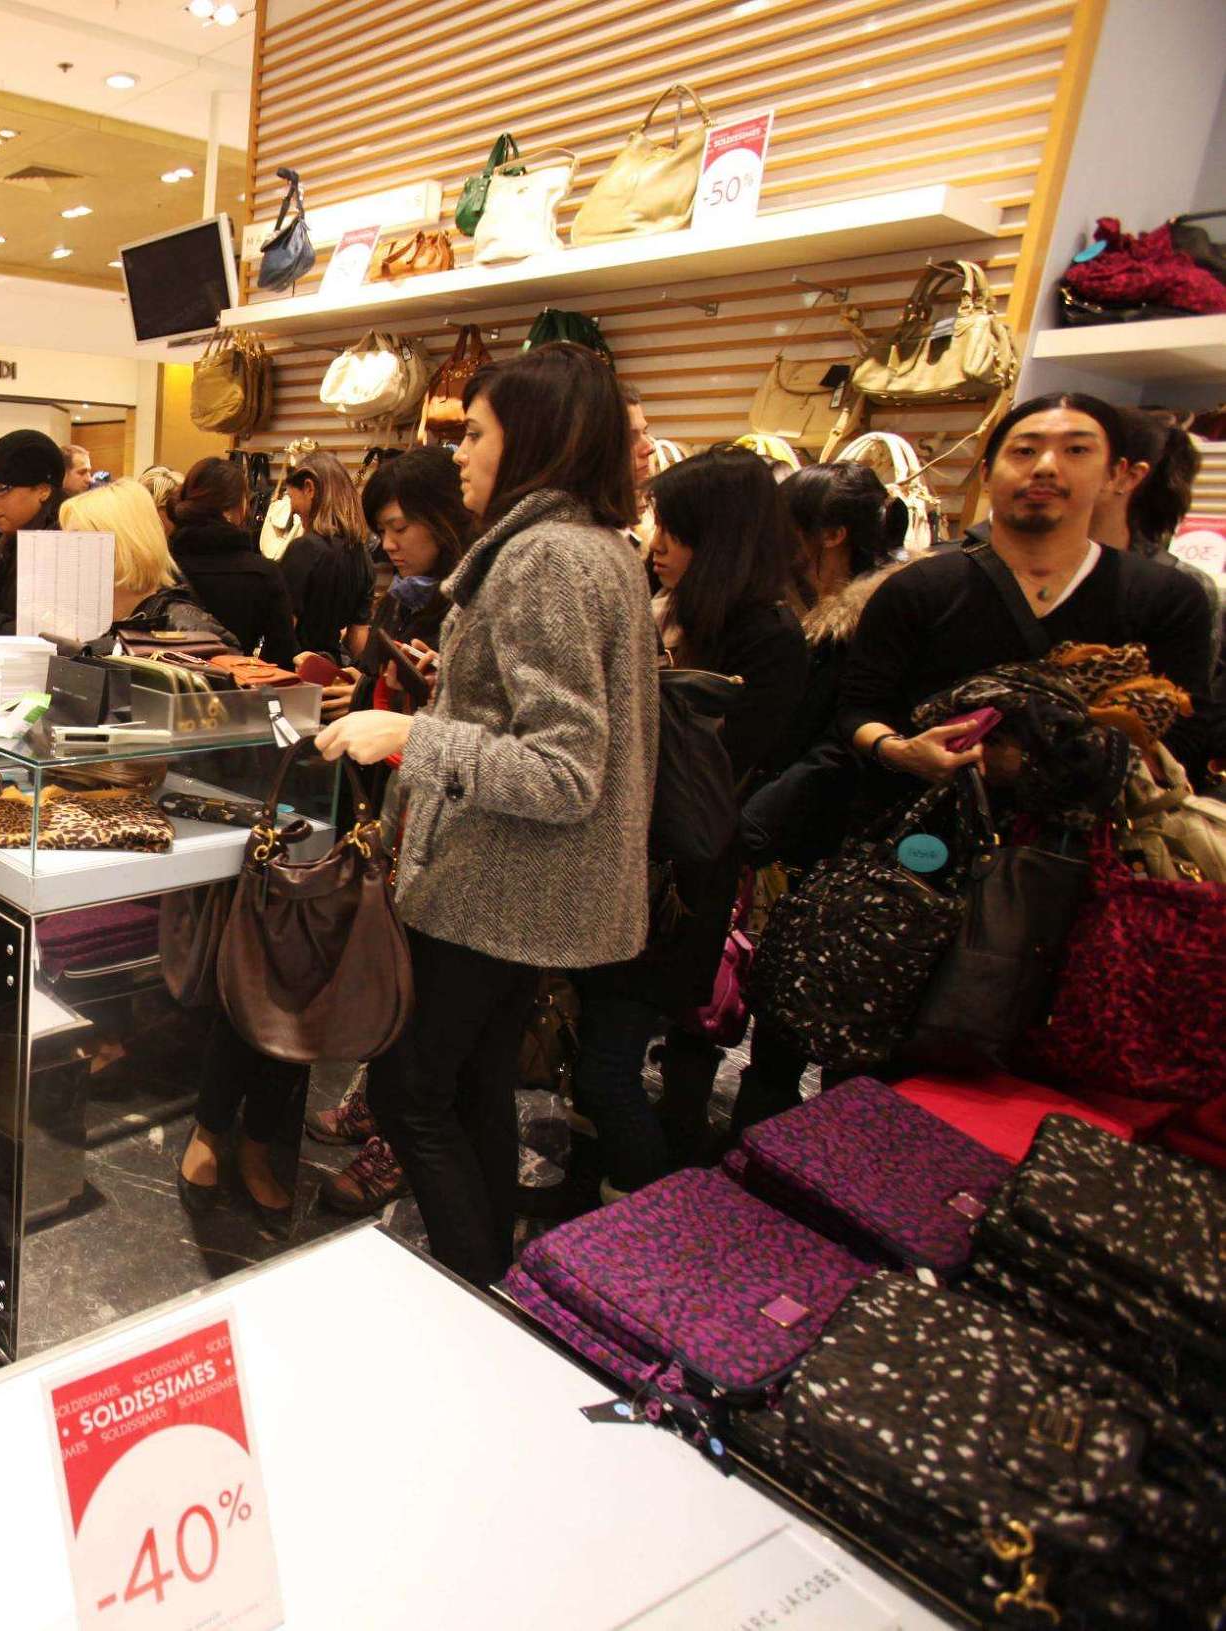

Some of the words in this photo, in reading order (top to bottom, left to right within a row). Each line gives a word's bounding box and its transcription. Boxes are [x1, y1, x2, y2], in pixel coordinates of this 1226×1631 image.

[703, 173, 755, 206] -50%
[79, 1359, 217, 1436] SOLDISSIMES
[97, 1482, 252, 1612] -40%
[737, 1609, 777, 1631] ARC
[778, 1568, 841, 1615] JACOBS
